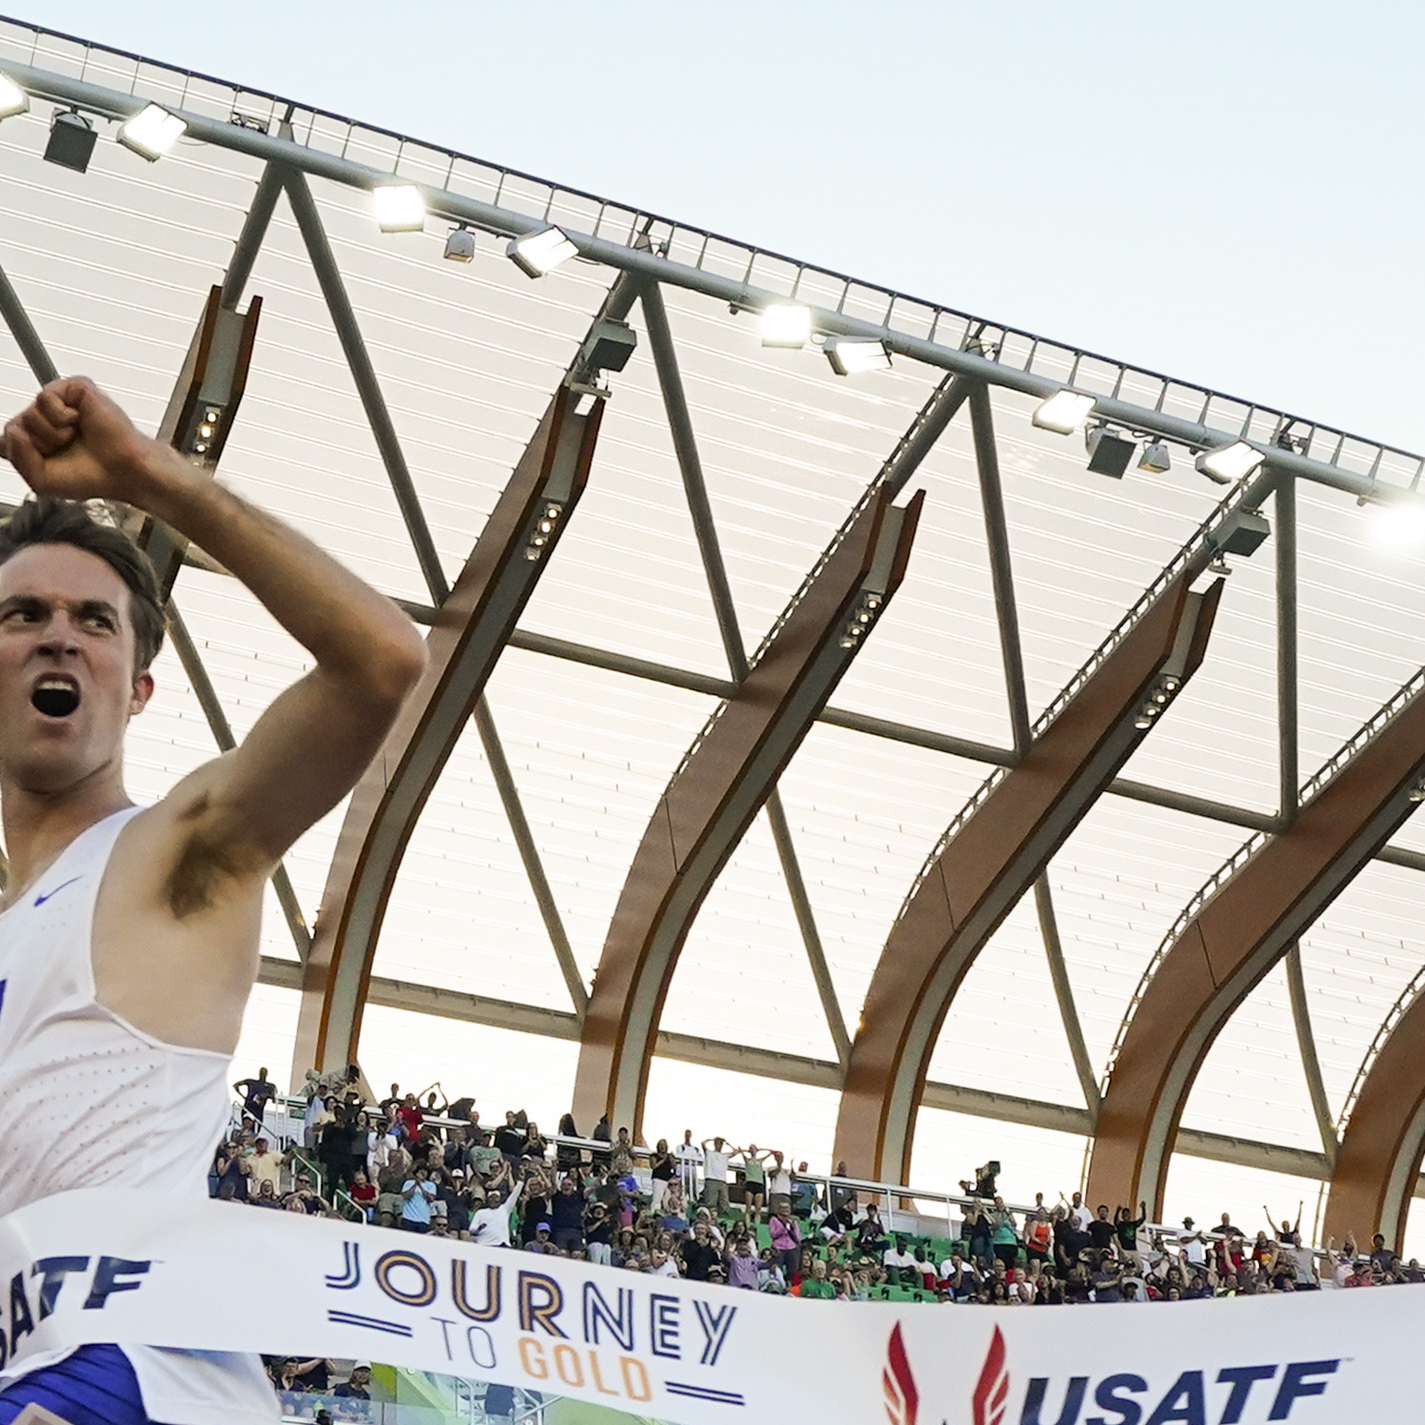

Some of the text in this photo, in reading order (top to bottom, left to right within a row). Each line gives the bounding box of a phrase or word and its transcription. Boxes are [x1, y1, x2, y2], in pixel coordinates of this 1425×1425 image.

[325, 1241, 738, 1366] JOURNEY
[430, 1316, 653, 1402] TO GOLD
